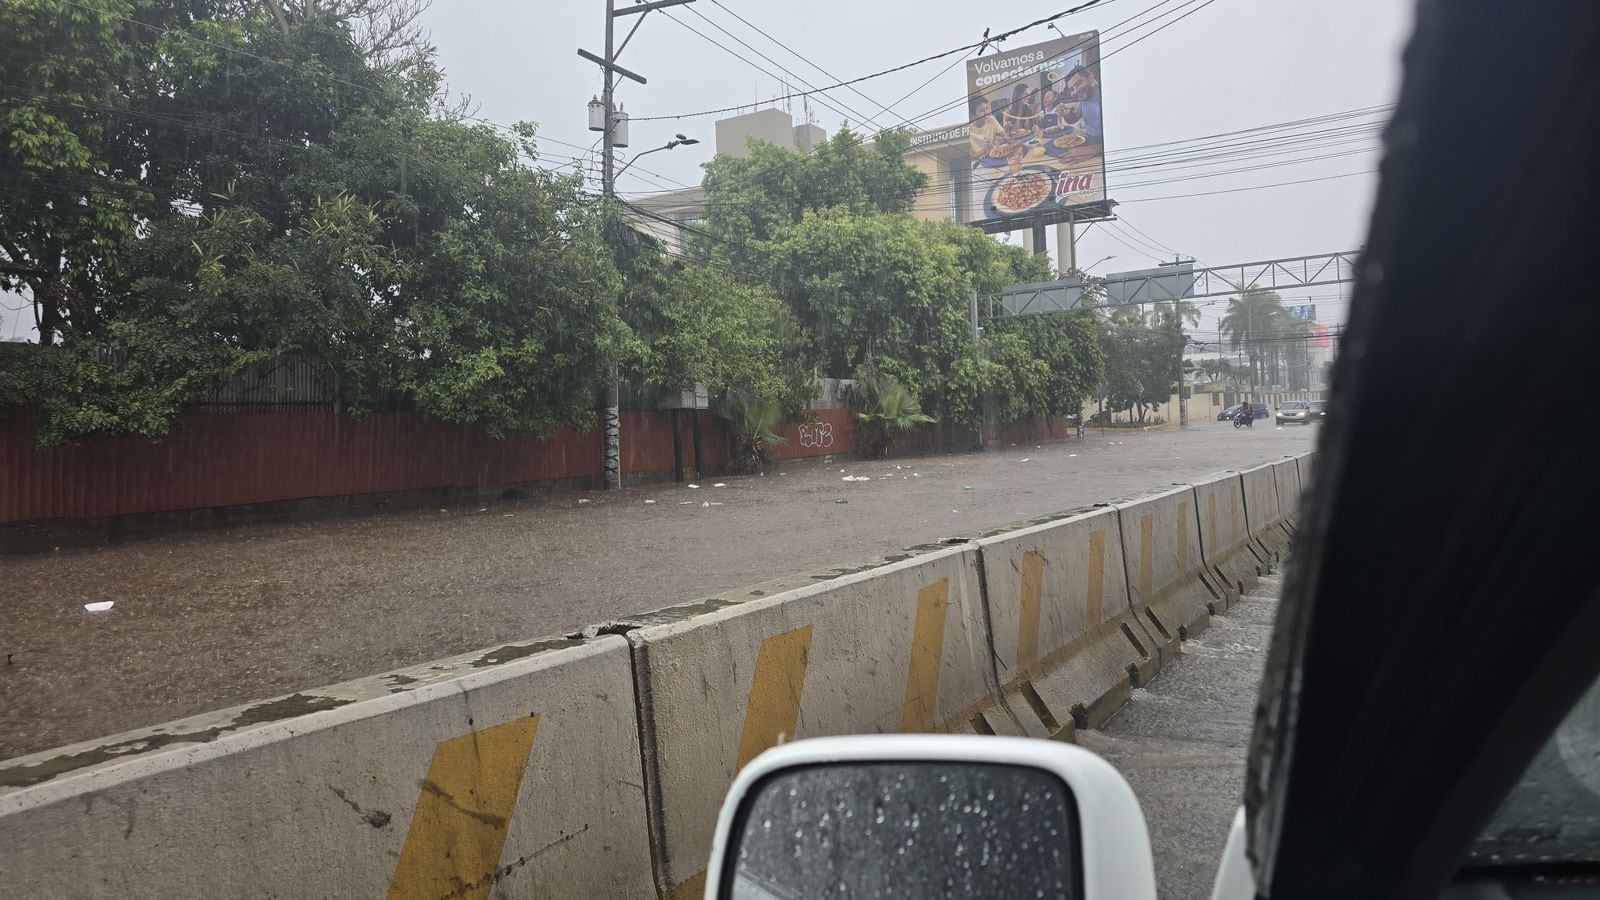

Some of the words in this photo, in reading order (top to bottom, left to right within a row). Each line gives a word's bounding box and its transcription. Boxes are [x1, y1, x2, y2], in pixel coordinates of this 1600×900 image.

[974, 52, 1034, 74] Volvamos
[1036, 50, 1044, 60] a
[975, 58, 1065, 86] conectarnos
[949, 128, 961, 139] DE
[1055, 170, 1094, 197] ina
